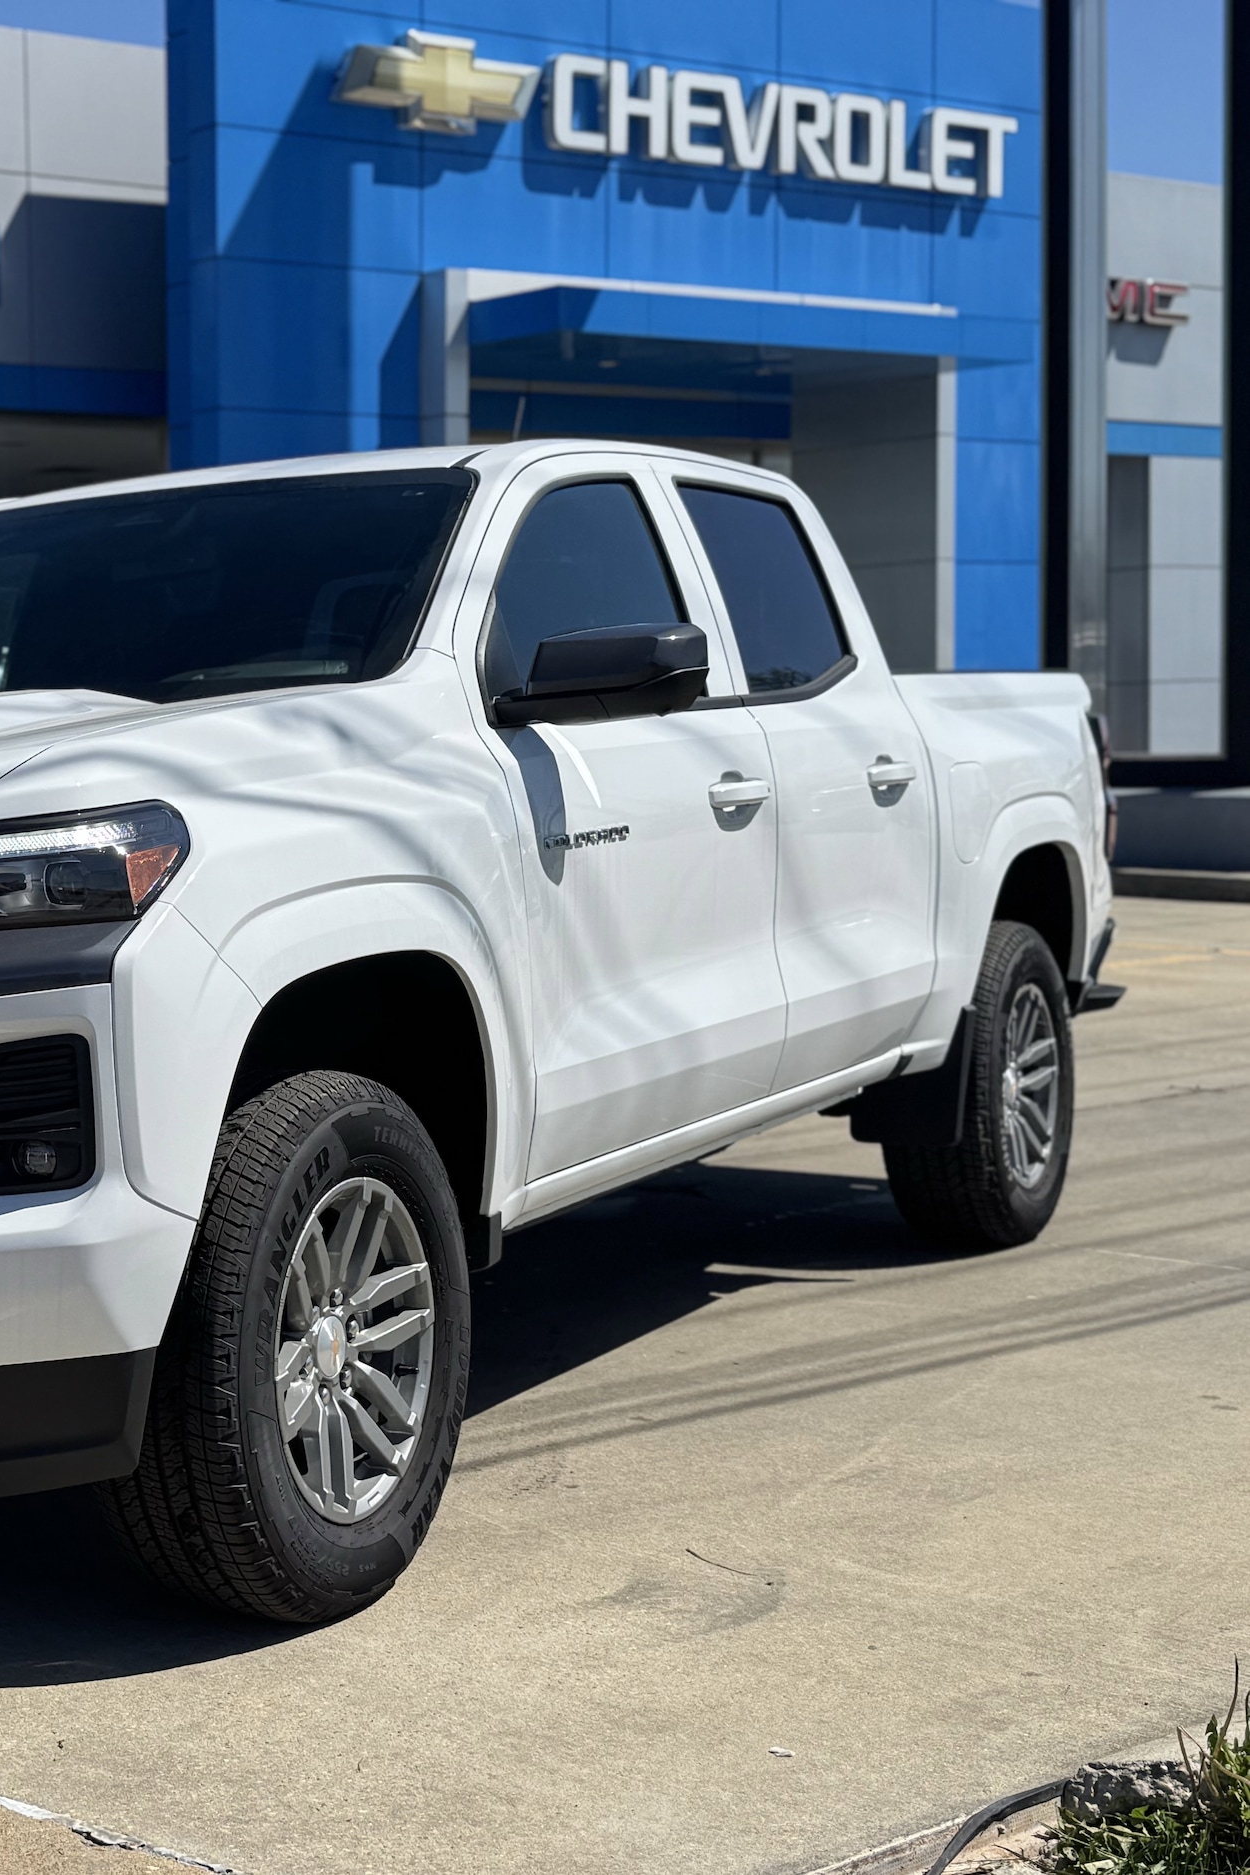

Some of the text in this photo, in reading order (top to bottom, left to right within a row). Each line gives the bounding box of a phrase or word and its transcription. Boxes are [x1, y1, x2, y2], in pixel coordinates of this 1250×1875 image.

[550, 53, 1018, 198] CHEVROLET
[1107, 278, 1190, 326] MC
[254, 1147, 331, 1387] WRANGLER
